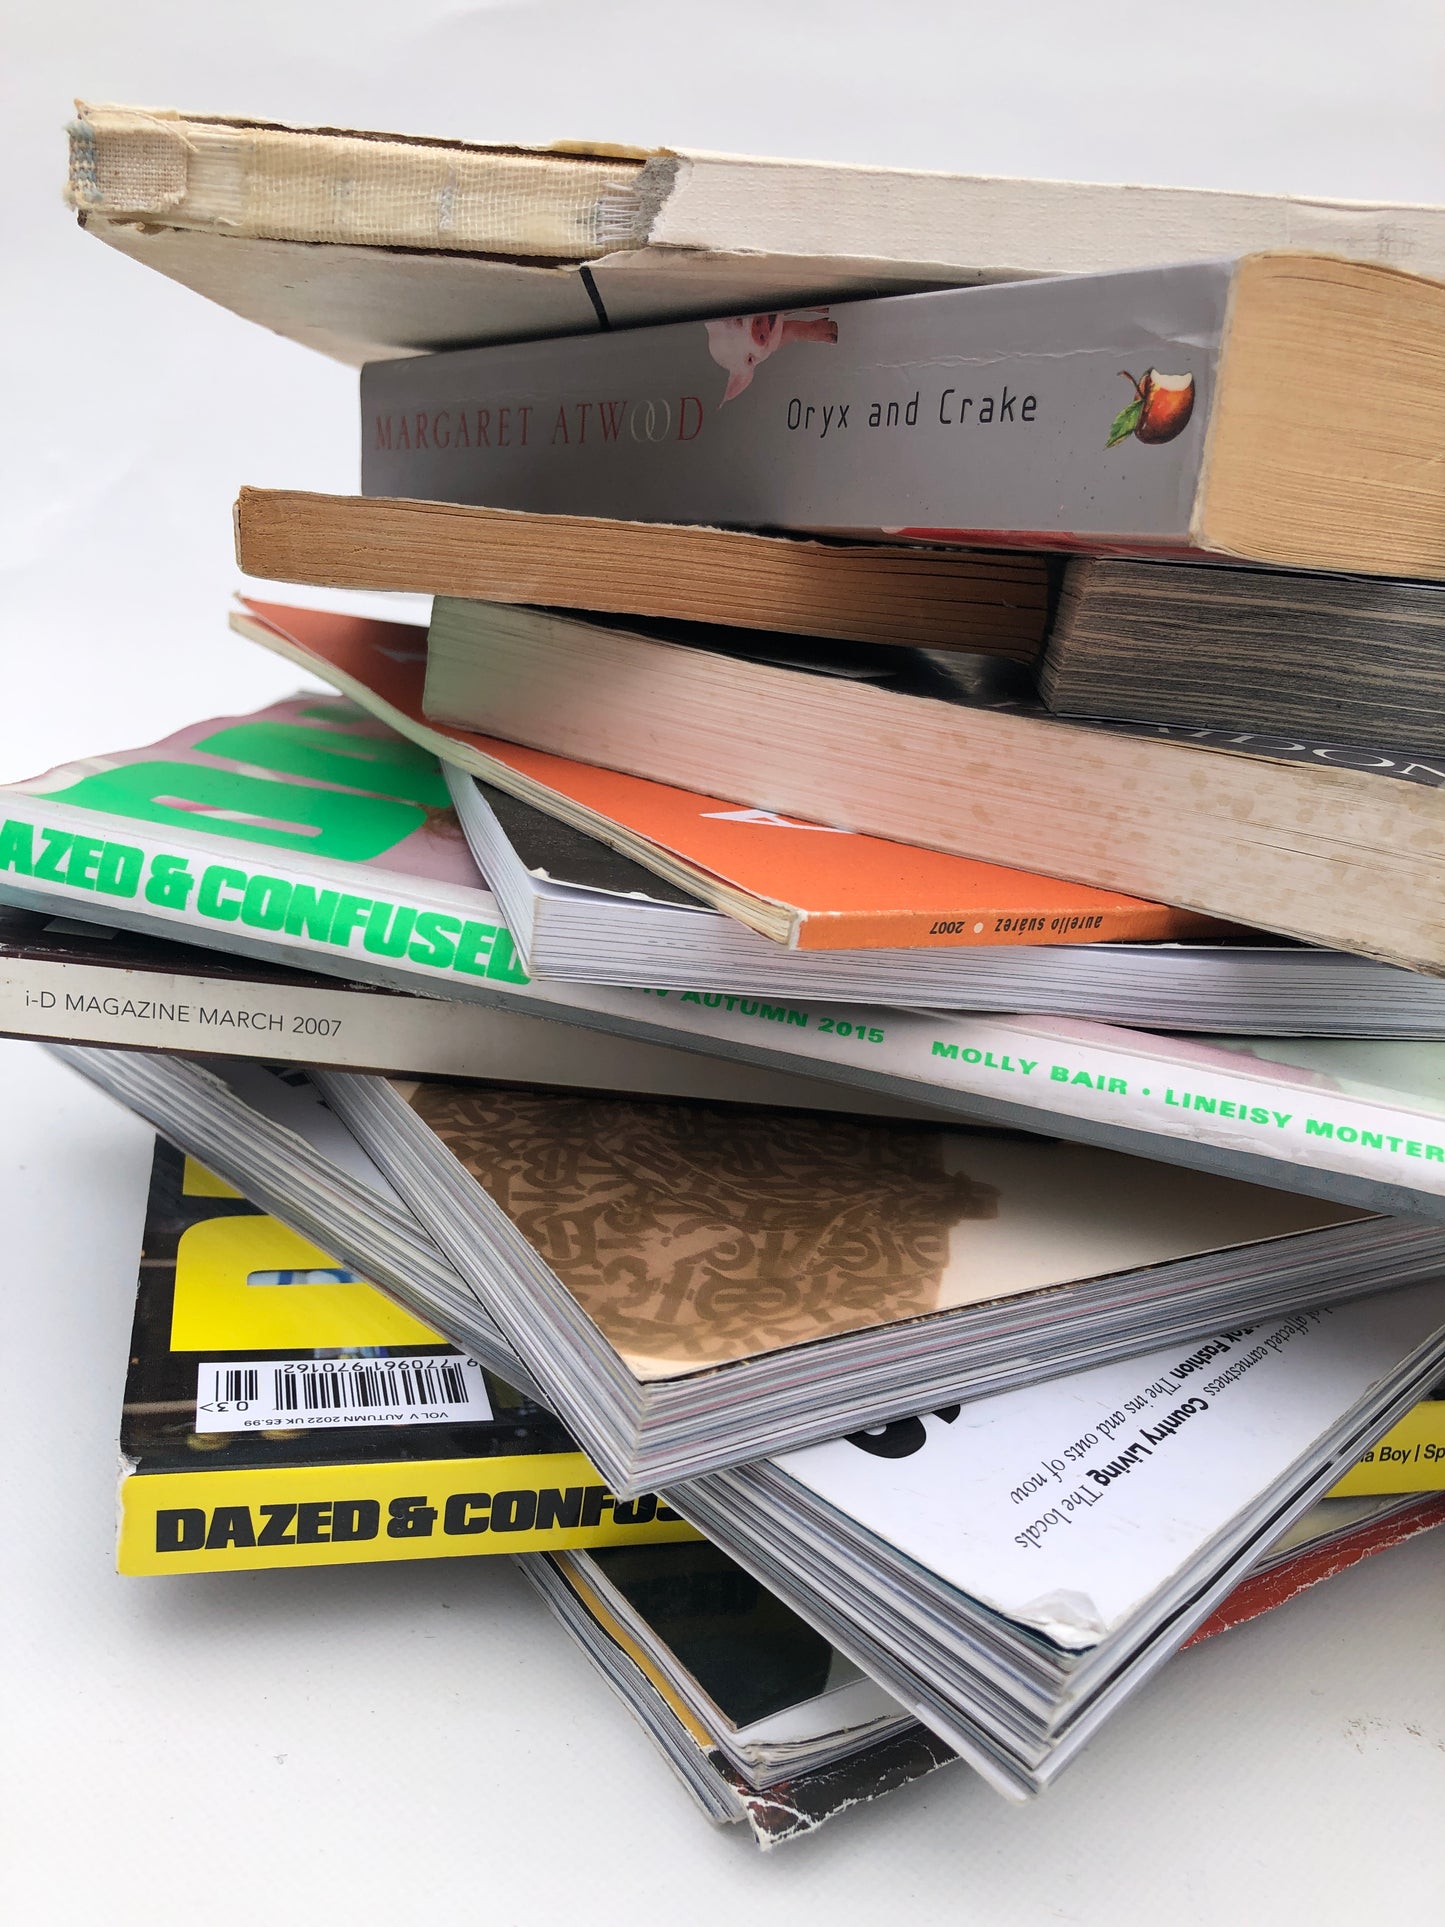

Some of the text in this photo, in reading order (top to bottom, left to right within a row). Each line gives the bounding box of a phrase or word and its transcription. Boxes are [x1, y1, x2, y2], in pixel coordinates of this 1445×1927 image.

[375, 386, 1038, 450] MARGARET ATWOOD Oryx and Crake
[0, 819, 145, 899] AZED
[145, 854, 195, 910] &
[929, 915, 1103, 936] aurelio suárez 2007
[25, 990, 342, 1037] i-D MAGAZINE MARCH 2007
[680, 991, 809, 1028] AUTUMN
[817, 1017, 885, 1044] 2015
[931, 1041, 1038, 1075] MOLLY
[1050, 1065, 1127, 1095] BAIR
[1165, 1088, 1293, 1129] LINEISY
[1305, 1119, 1445, 1163] MONTER
[1169, 1339, 1231, 1379] Fashion
[1203, 1346, 1268, 1396] earnestness
[1145, 1377, 1182, 1399] The
[307, 1416, 340, 1424] 2022
[344, 1413, 404, 1422] AUTUMN
[1124, 1395, 1154, 1414] ins
[244, 1418, 281, 1427] £5.99
[1096, 1410, 1126, 1441] and
[1139, 1397, 1209, 1446] Country
[1064, 1433, 1099, 1462] outs
[1379, 1446, 1411, 1464] Boy
[1041, 1459, 1066, 1483] of
[1085, 1442, 1153, 1486] Living
[1010, 1472, 1048, 1504] now
[1061, 1484, 1104, 1507] The
[155, 1485, 685, 1553] DAZED & CONFU
[1014, 1508, 1072, 1549] locals
